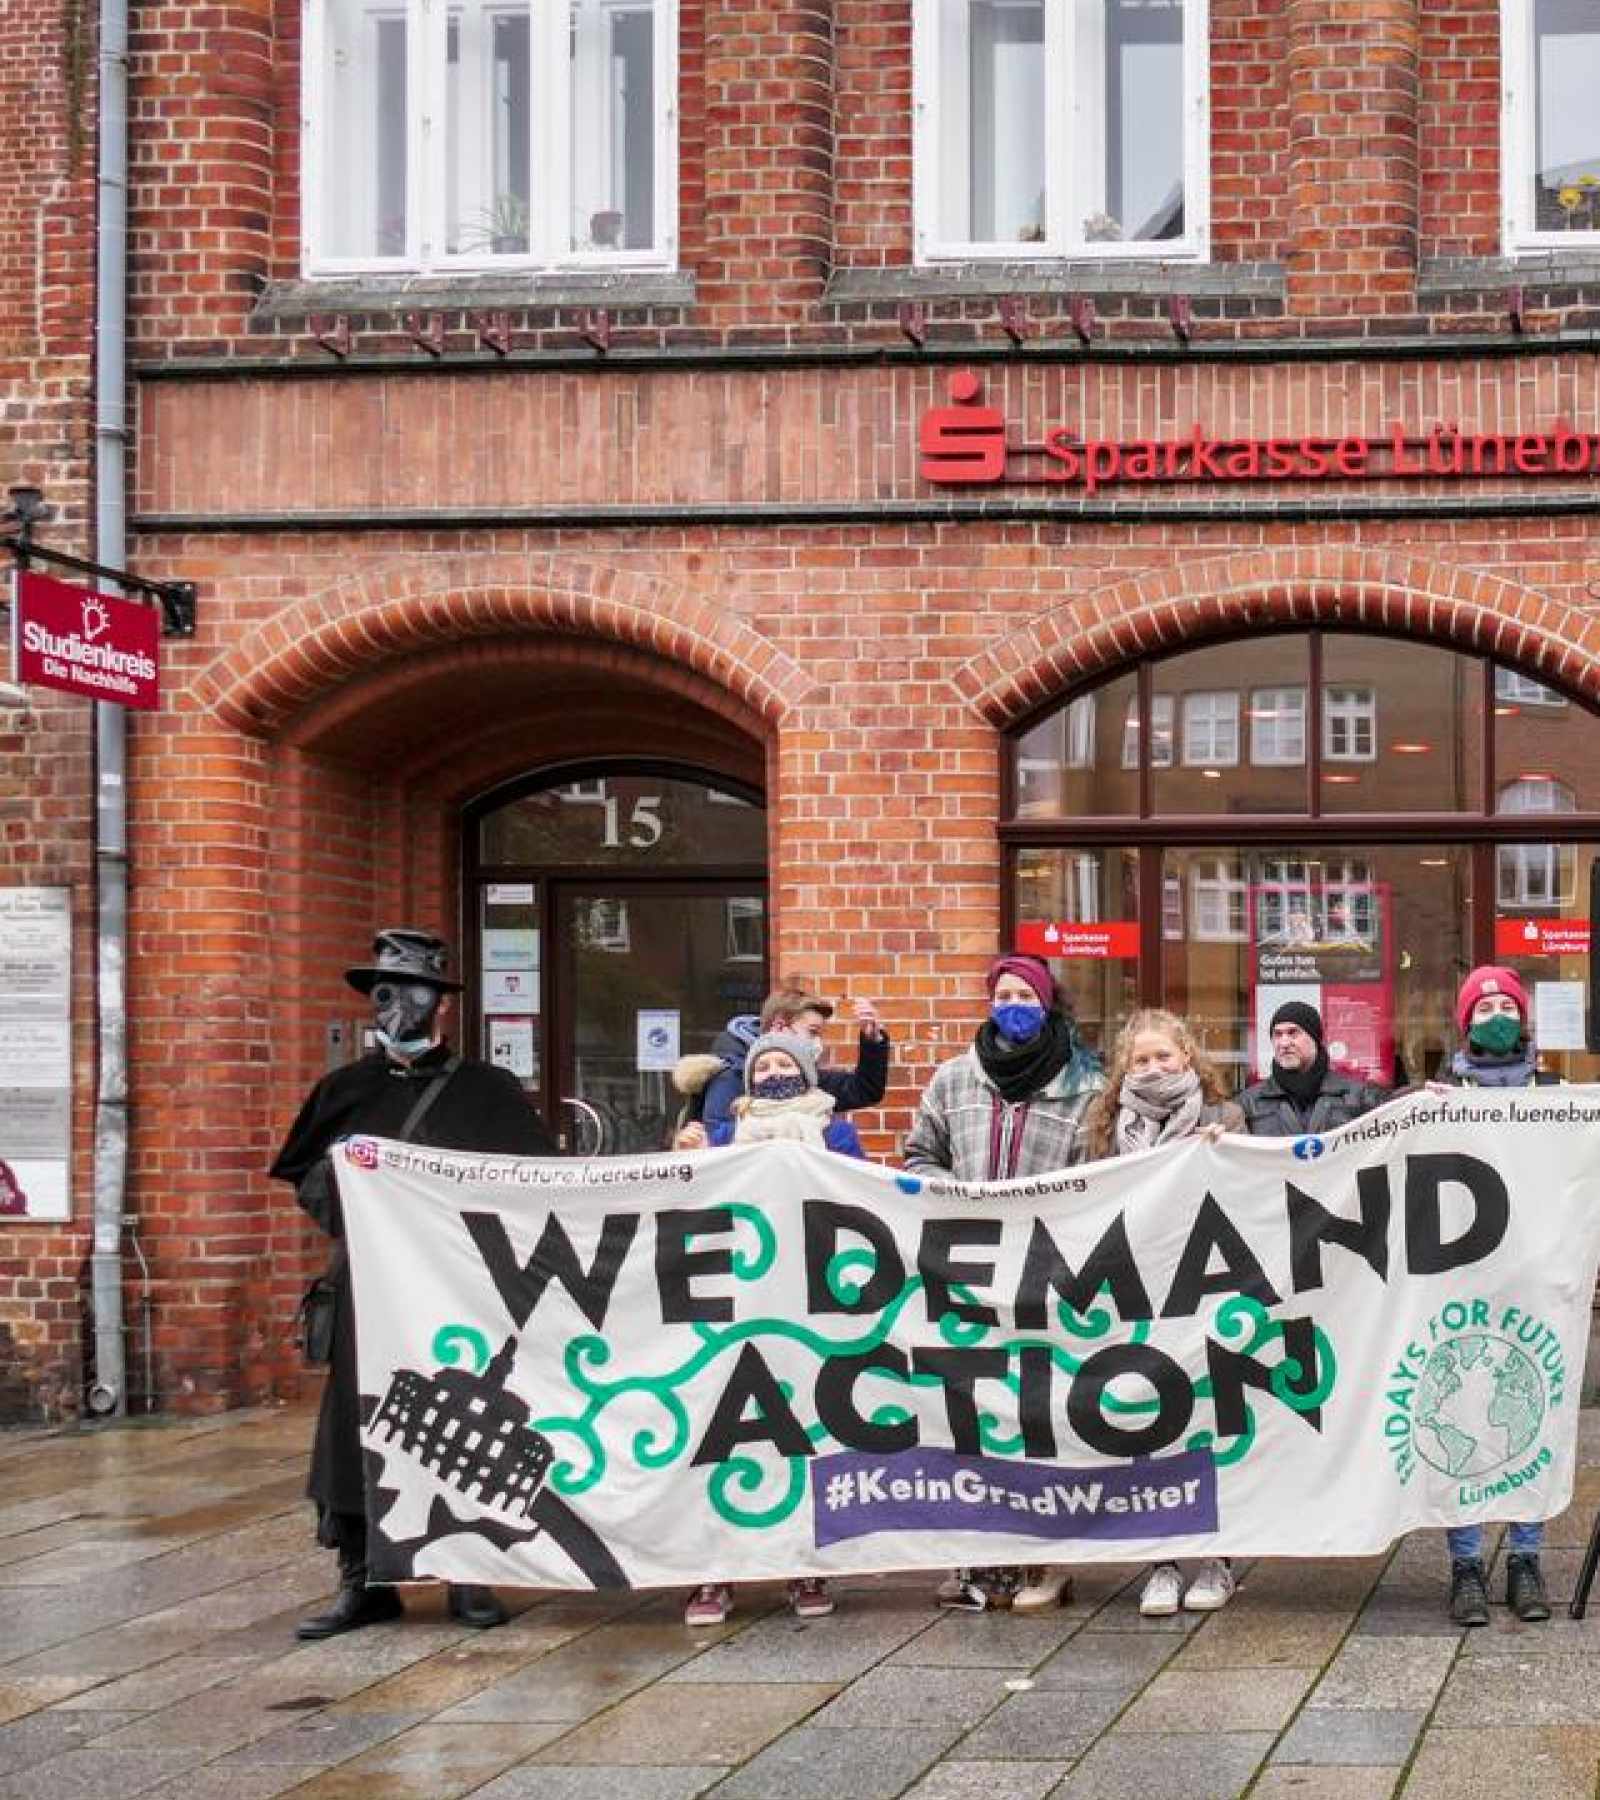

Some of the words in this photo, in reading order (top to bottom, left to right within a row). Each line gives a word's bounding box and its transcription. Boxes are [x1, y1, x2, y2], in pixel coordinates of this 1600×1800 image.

[1044, 424, 1368, 490] Sparkasse
[24, 621, 156, 681] Studienkreis
[43, 658, 69, 678] Die
[72, 664, 139, 695] Nachhilfe
[601, 797, 662, 847] 15
[1062, 932, 1110, 944] Sparkasse
[1542, 928, 1590, 940] Sparkasse
[460, 1208, 735, 1332] WE
[802, 1153, 1510, 1330] DEMAND
[1429, 1299, 1490, 1342] FOR
[1500, 1306, 1566, 1408] FUTURE
[691, 1316, 1323, 1467] ACTION
[826, 1467, 1201, 1515] #KeinGradWeiter
[1459, 1447, 1553, 1505] Lüneburg
